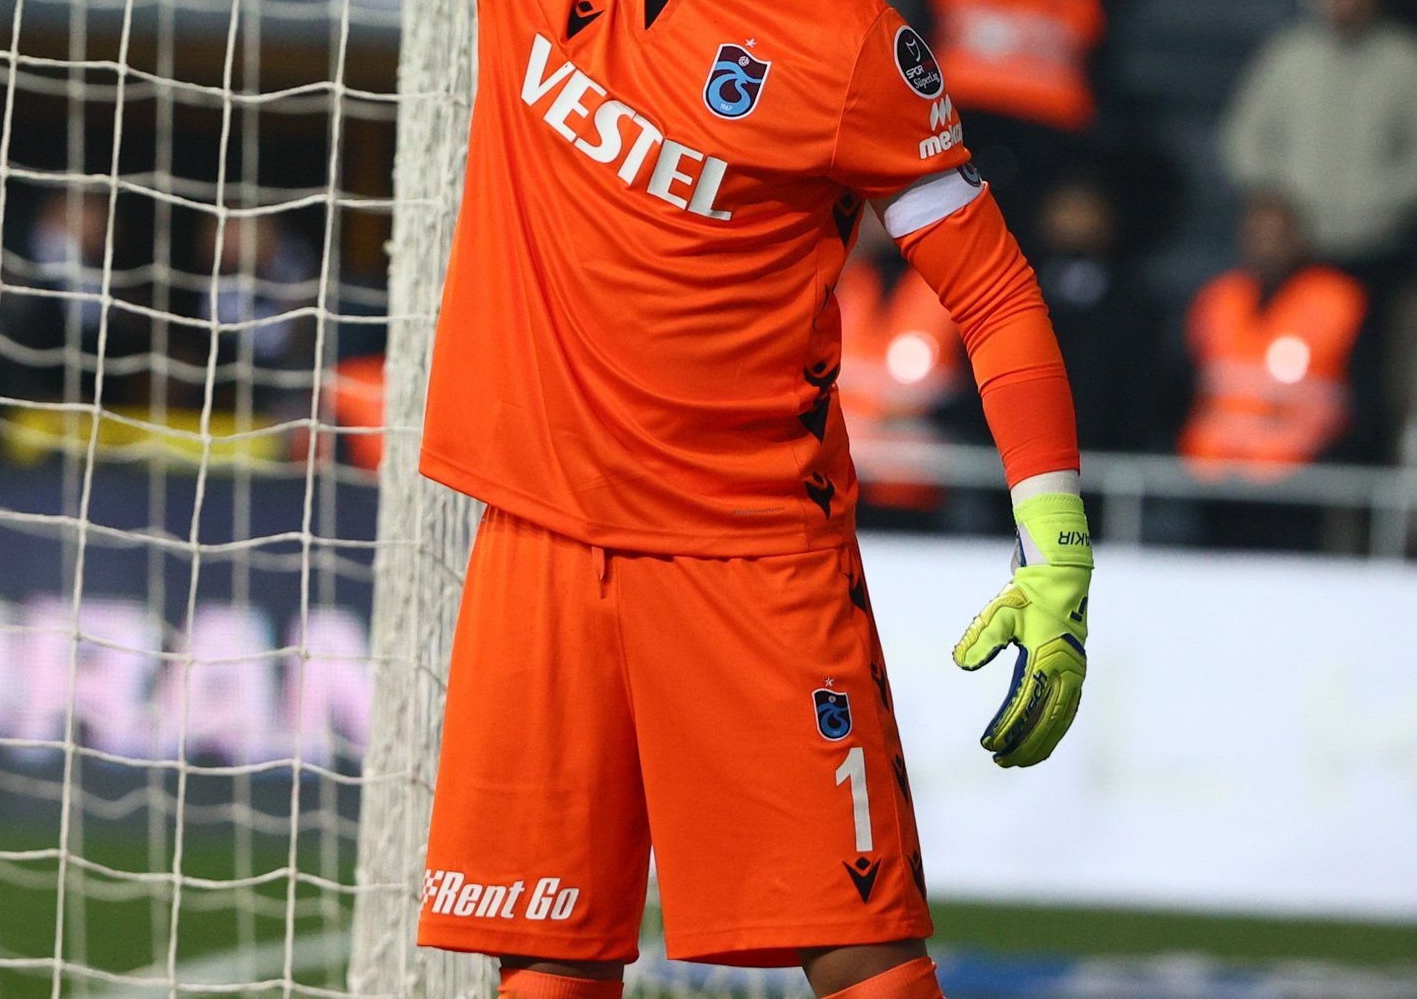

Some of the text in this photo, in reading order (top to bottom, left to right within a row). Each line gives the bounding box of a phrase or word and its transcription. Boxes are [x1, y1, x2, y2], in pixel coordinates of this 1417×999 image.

[520, 32, 732, 222] VESTEL
[1058, 531, 1090, 546] AKIR
[835, 746, 873, 853] 1
[431, 871, 580, 920] Rent Go
